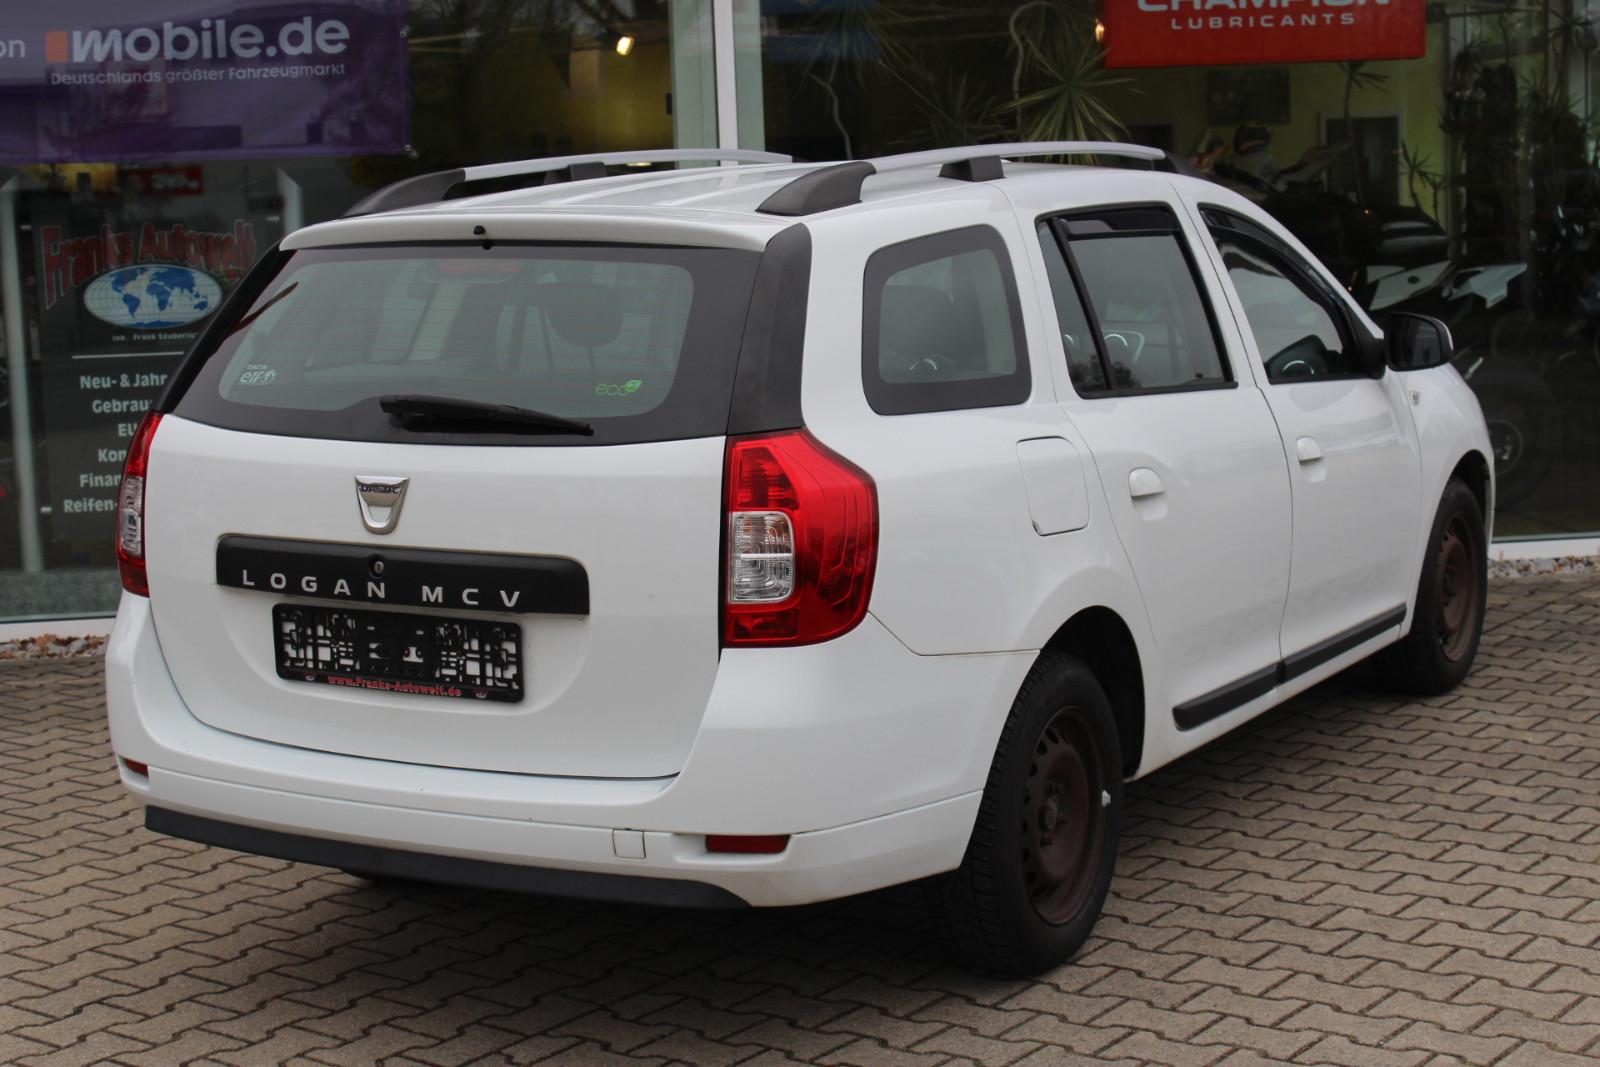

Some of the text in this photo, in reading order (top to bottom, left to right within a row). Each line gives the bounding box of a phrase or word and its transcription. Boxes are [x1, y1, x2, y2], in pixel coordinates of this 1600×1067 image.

[1171, 13, 1355, 30] LUBRICANTS
[72, 16, 350, 62] mobile.de
[51, 63, 345, 86] Deutschlands größter Fahrzeugmarkt
[40, 218, 257, 309] Franks Autowelt
[79, 374, 118, 389] Neu-
[120, 373, 131, 388] &
[92, 398, 153, 413] Gebrau
[63, 498, 118, 513] Reifen-
[242, 568, 521, 608] LOGAN MCV
